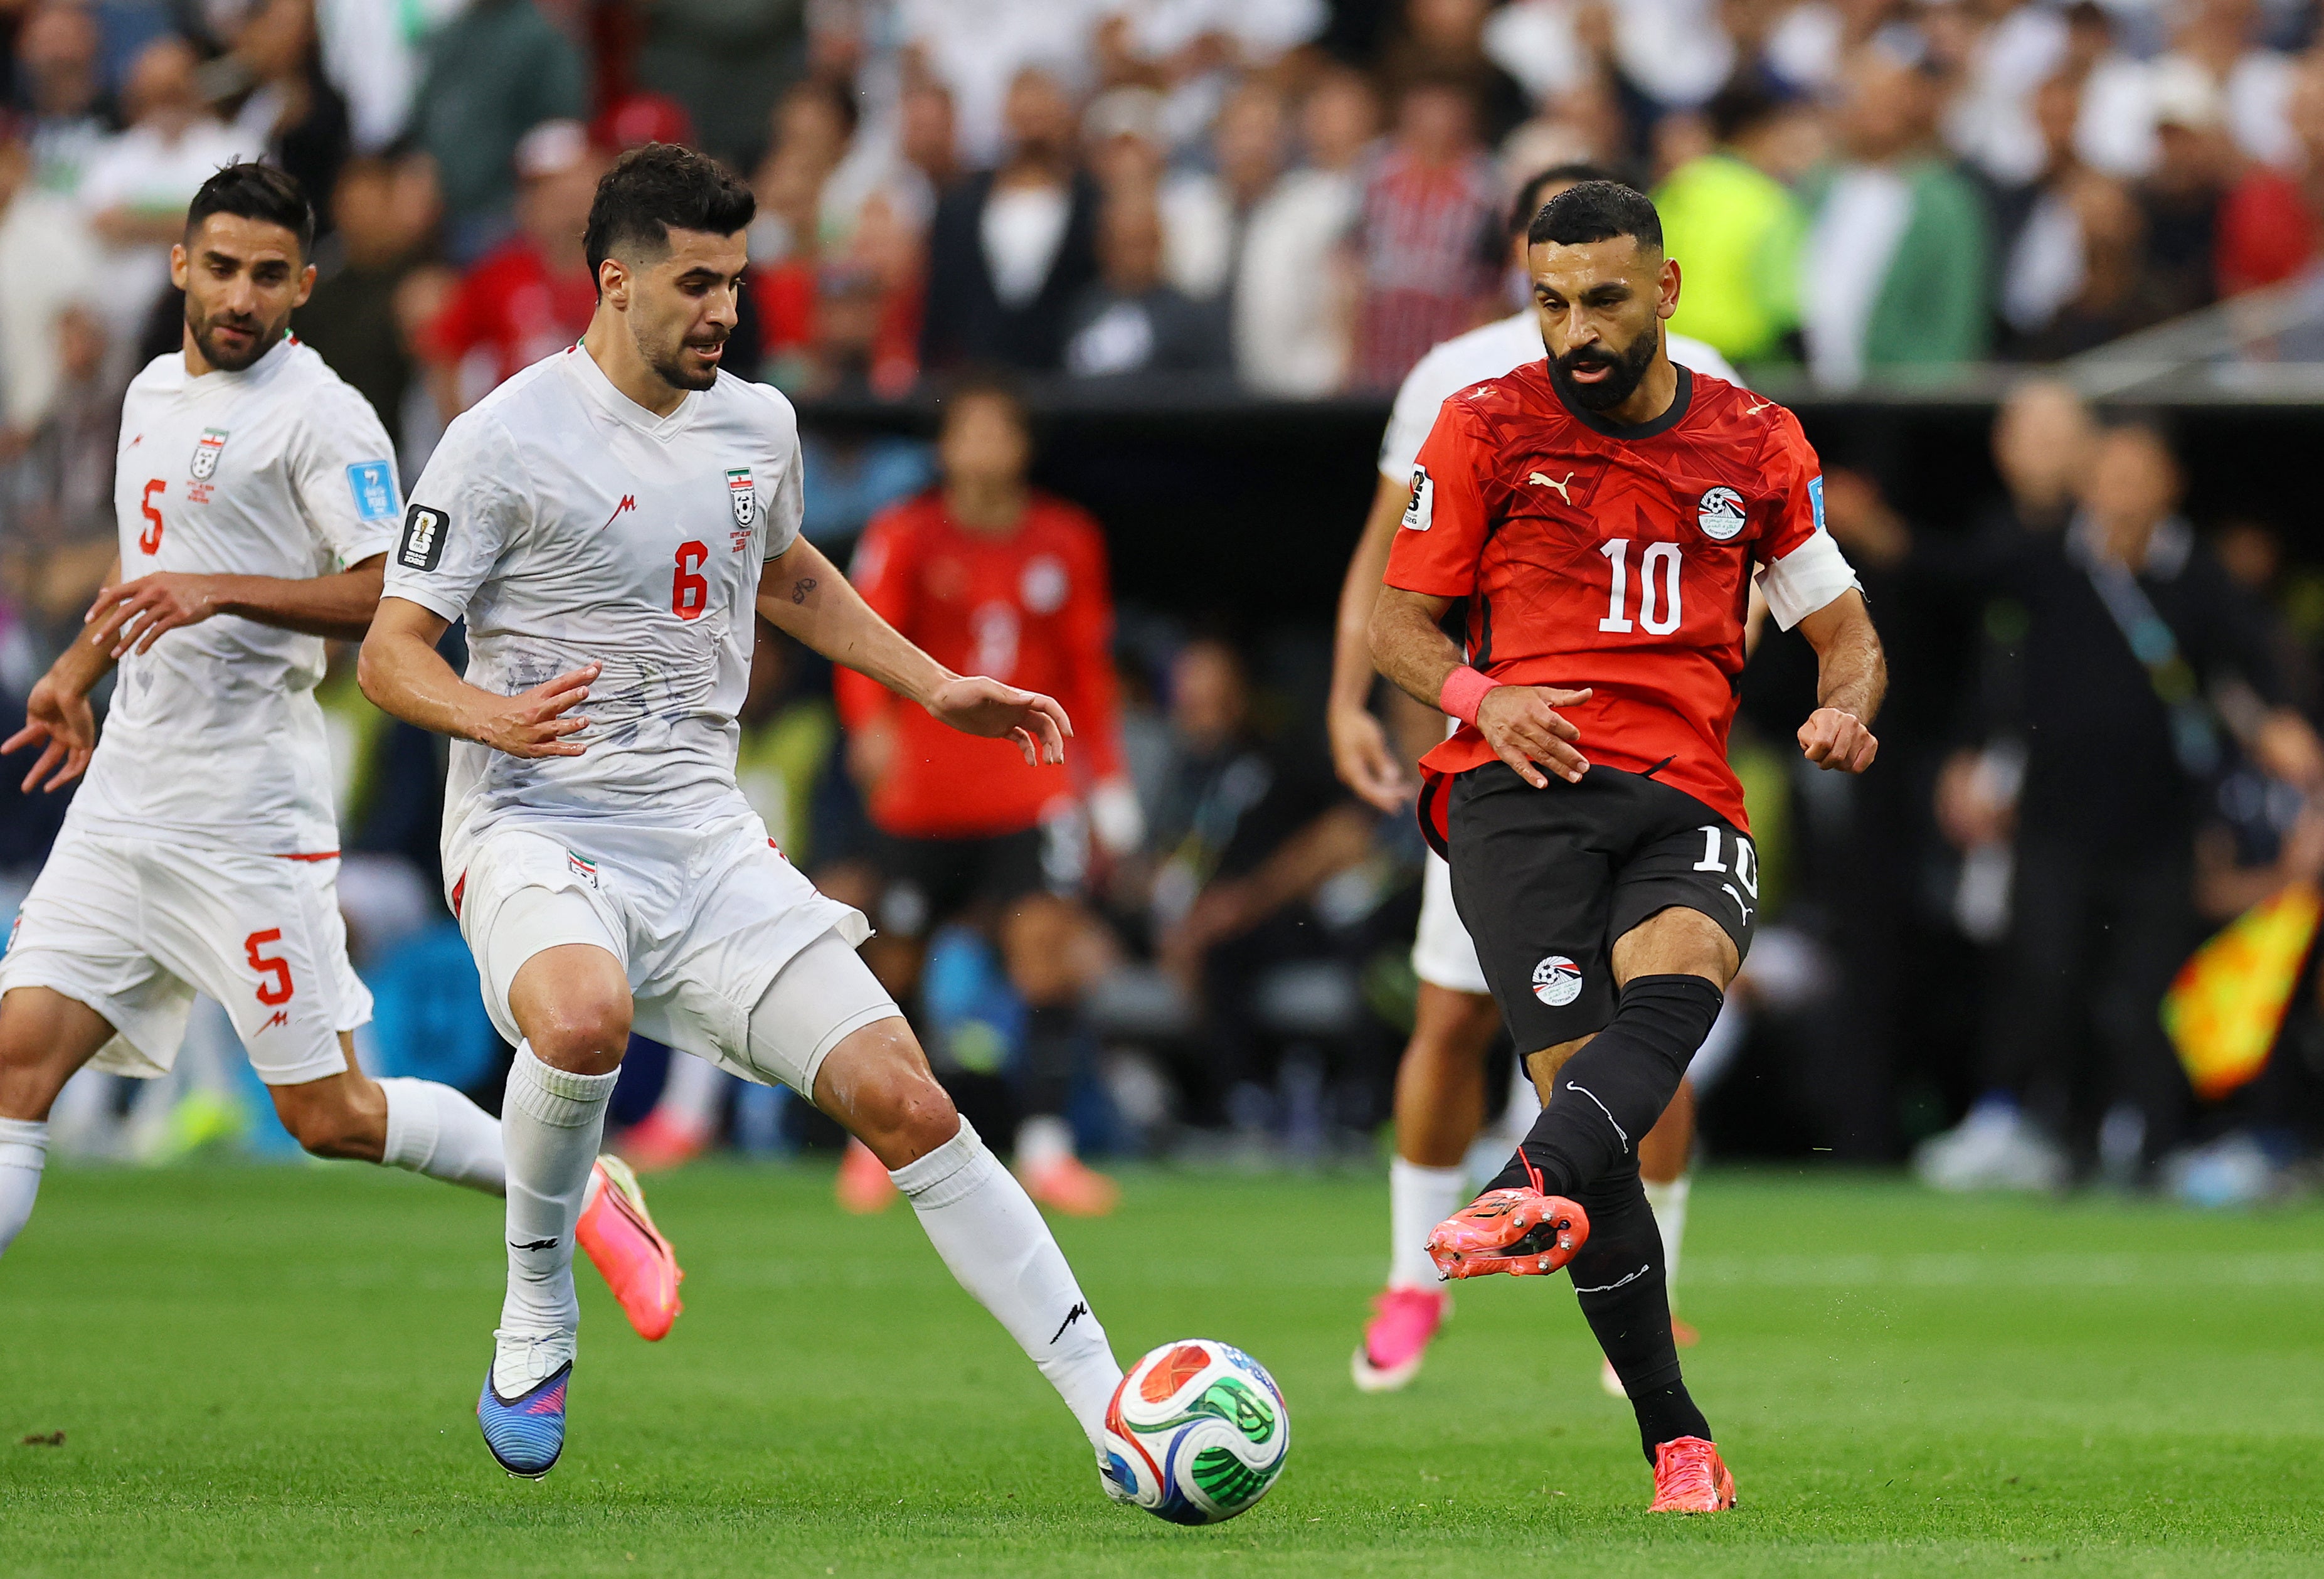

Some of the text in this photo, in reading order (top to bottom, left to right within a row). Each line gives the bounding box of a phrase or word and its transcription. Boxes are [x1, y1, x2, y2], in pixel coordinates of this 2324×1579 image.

[139, 479, 166, 555] 5
[403, 555, 426, 566] 2026
[672, 540, 708, 620] 6
[1598, 538, 1683, 635] 10
[1693, 825, 1758, 900] 10
[245, 927, 294, 1006] 5
